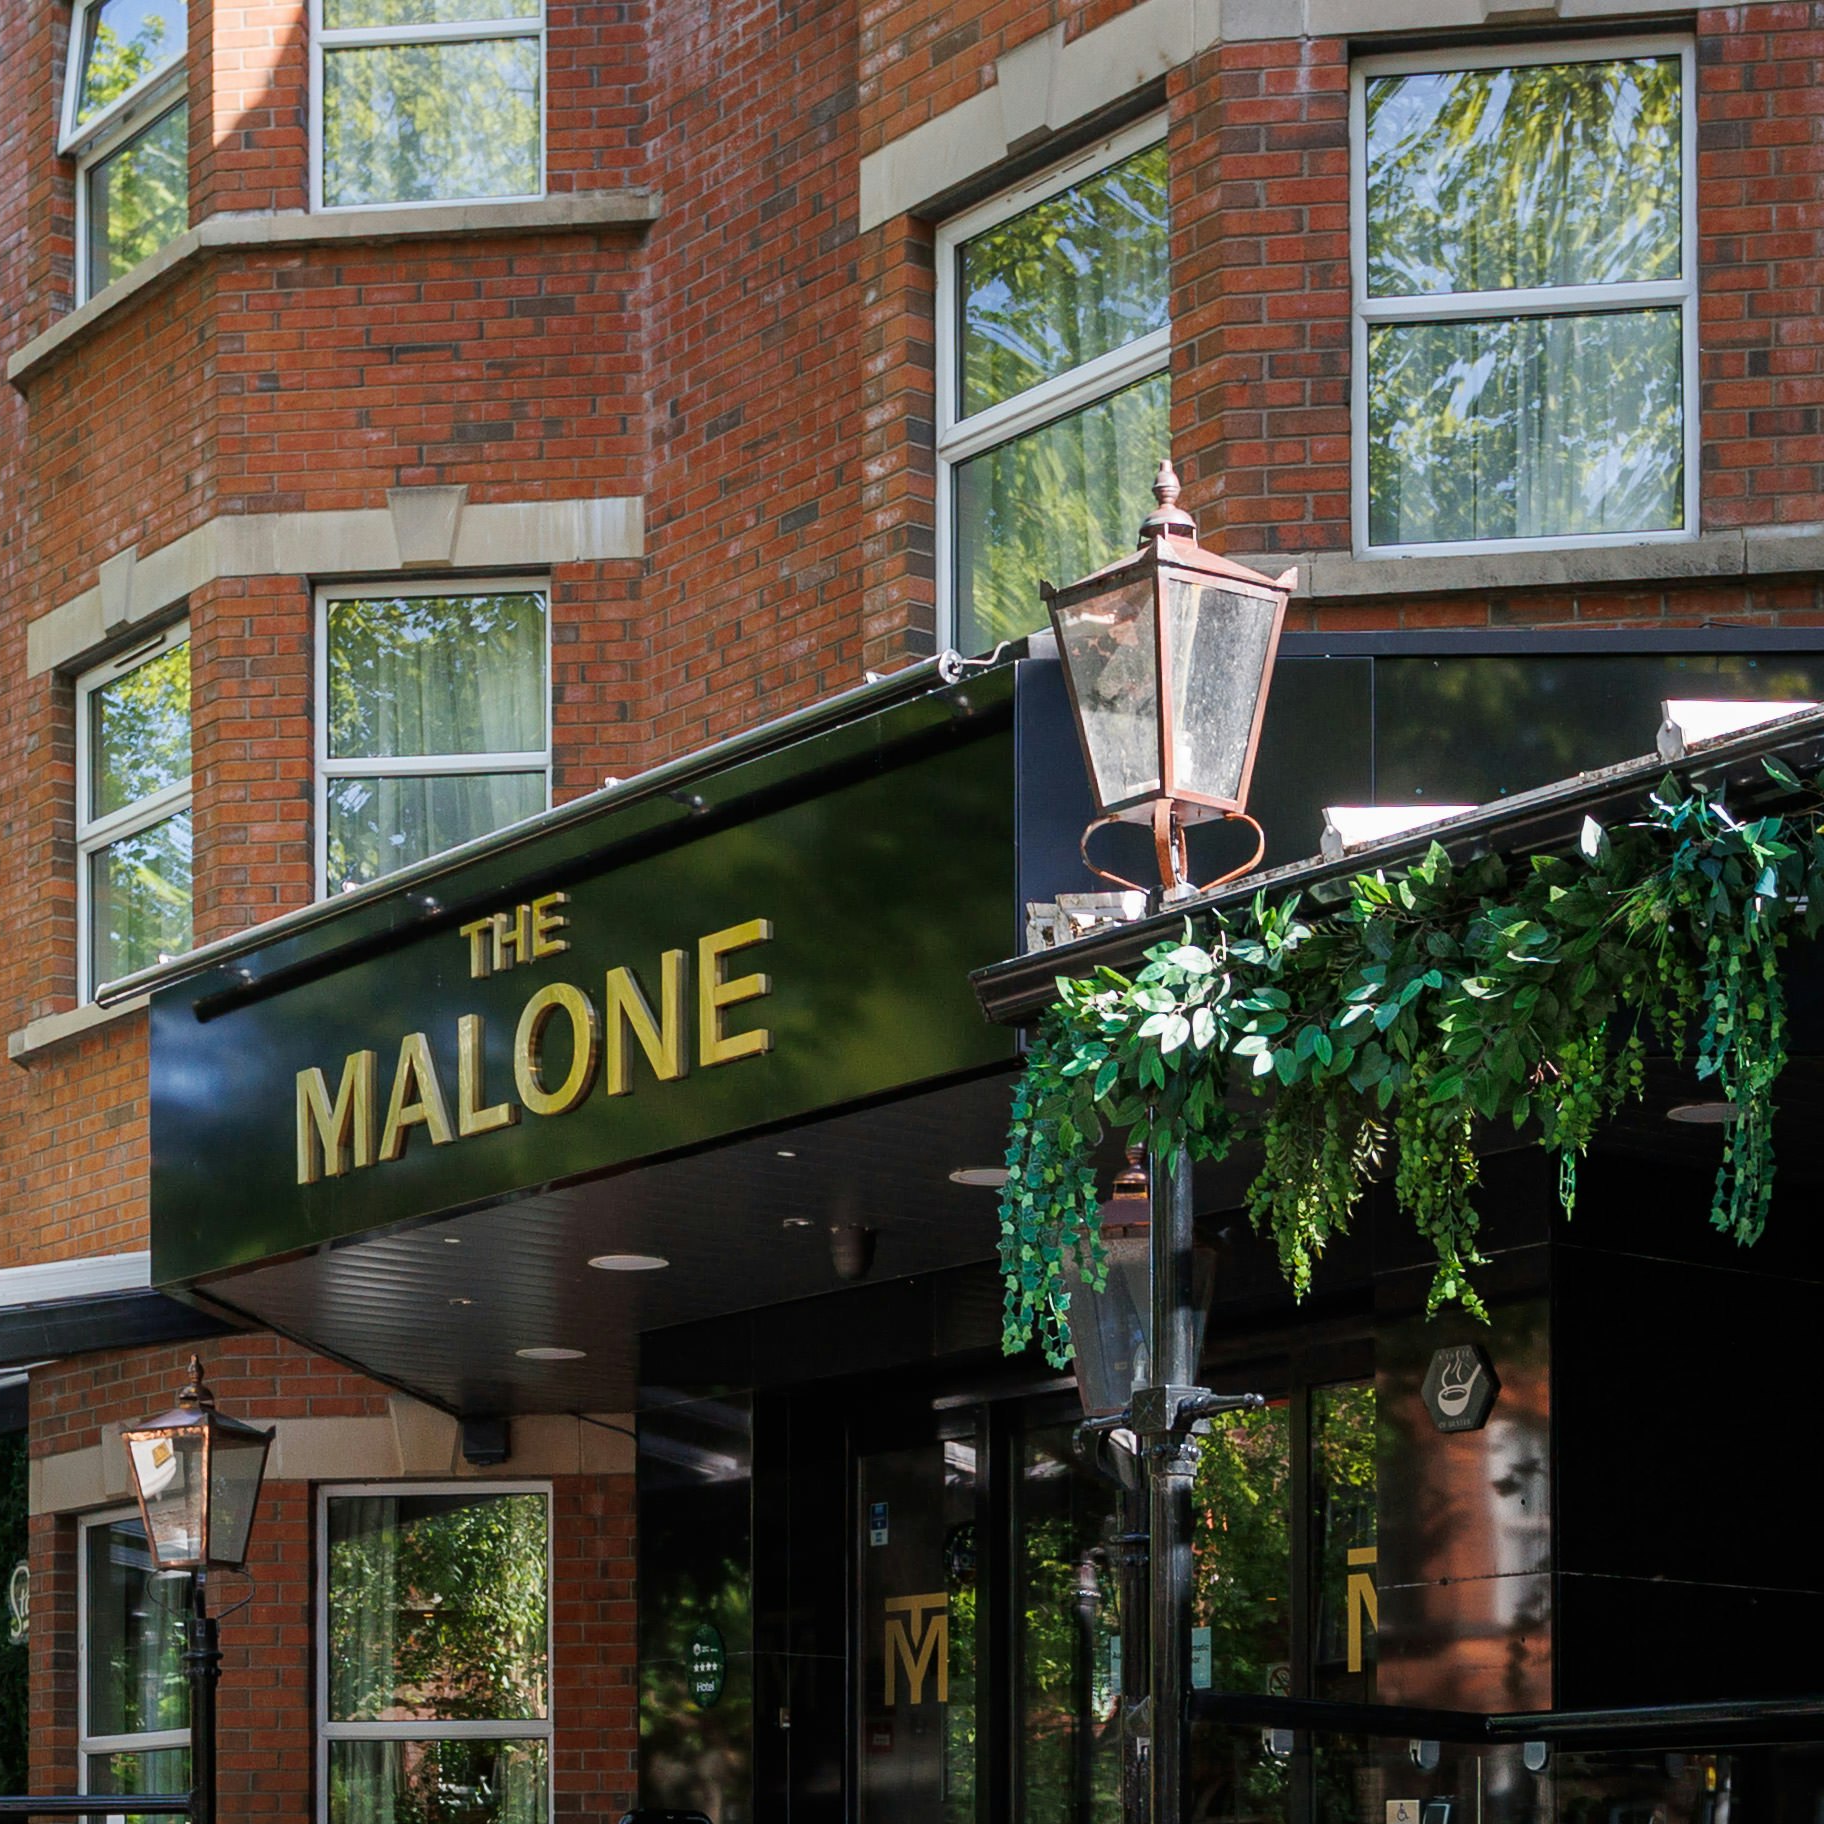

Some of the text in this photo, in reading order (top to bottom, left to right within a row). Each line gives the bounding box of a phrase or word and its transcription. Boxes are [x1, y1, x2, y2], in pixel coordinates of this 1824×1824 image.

[460, 891, 570, 979] THE
[296, 918, 773, 1185] MALONE
[696, 1680, 715, 1693] Hotel
